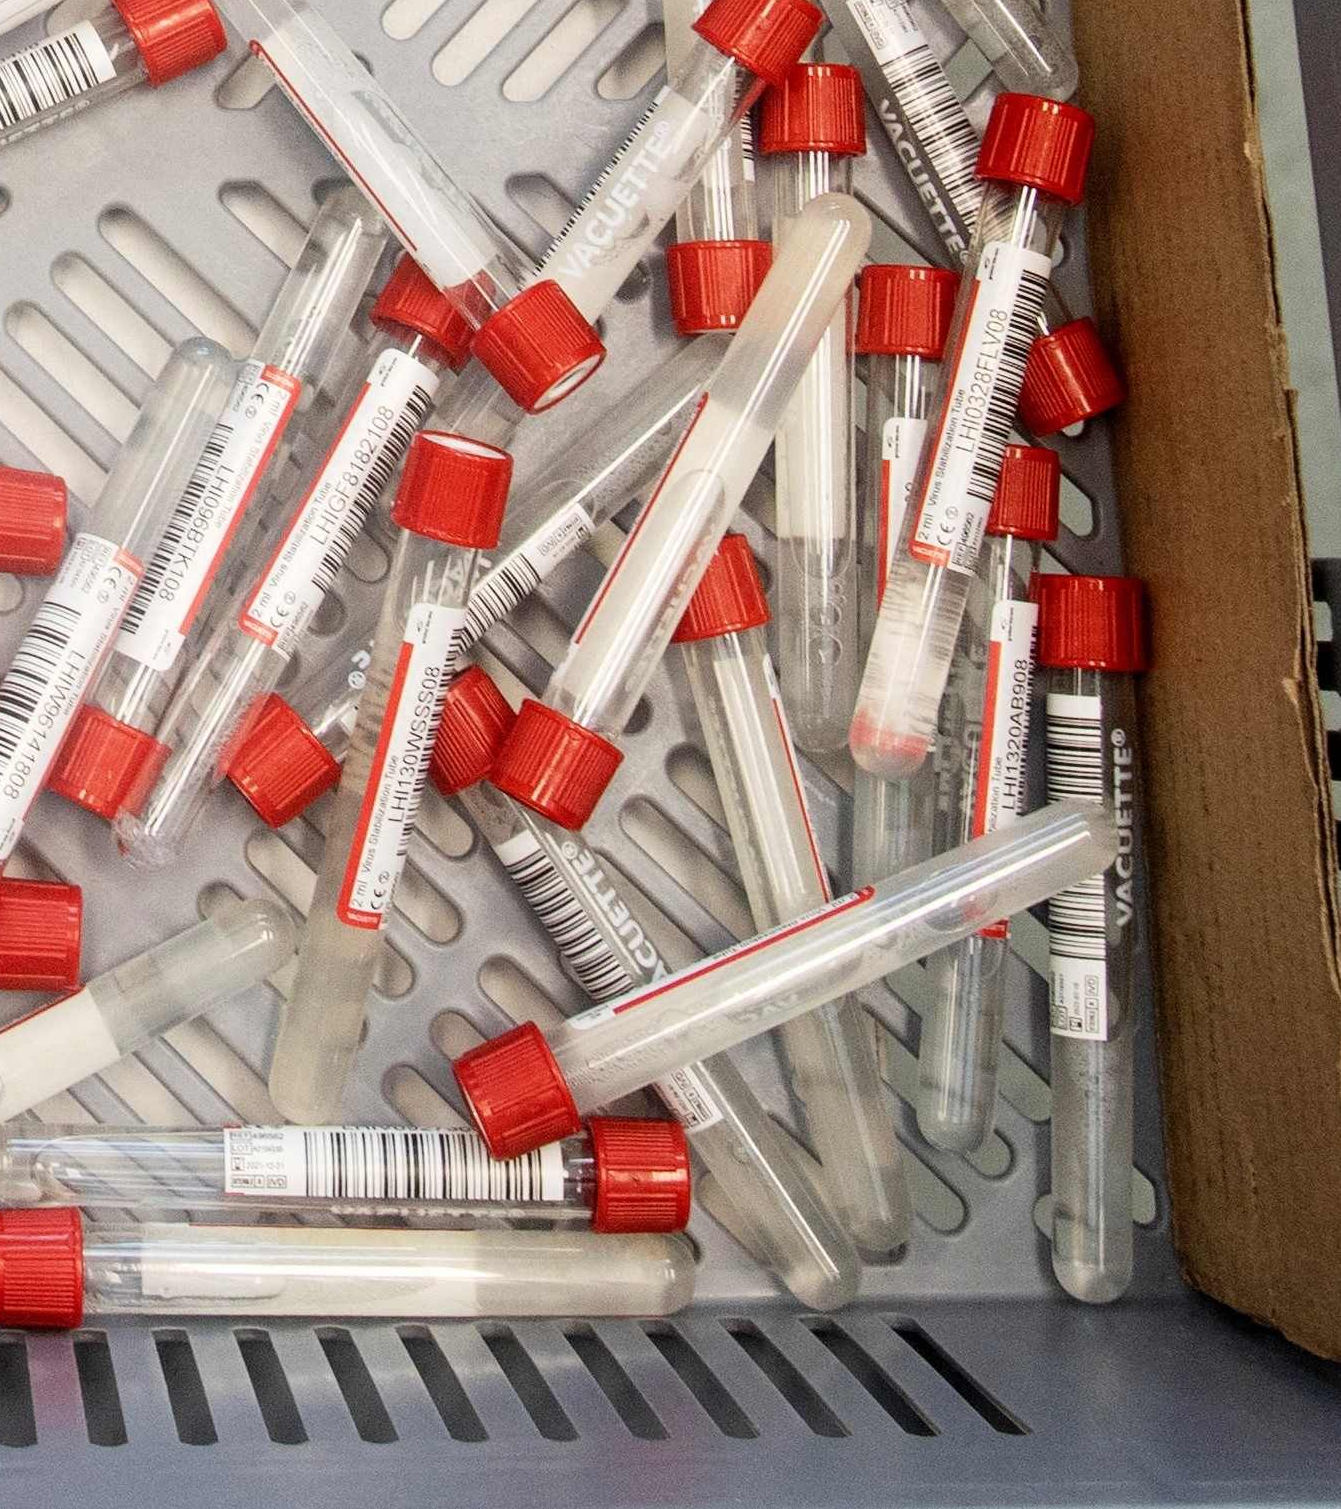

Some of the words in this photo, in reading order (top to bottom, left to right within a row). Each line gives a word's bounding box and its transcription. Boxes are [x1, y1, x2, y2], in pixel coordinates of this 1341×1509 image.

[958, 306, 1006, 453] LHI0328FLV08
[309, 403, 395, 546] LHIGF8182108
[921, 513, 933, 529] ml
[927, 479, 942, 507] Virus
[952, 388, 965, 414] Tube
[157, 464, 234, 602] LHI096BTK108
[267, 560, 288, 588] Virus
[313, 480, 332, 506] Tube
[2, 650, 85, 801] LHIW96141808
[387, 663, 440, 823] LHI130WSSS08
[992, 756, 1003, 781] Tube
[1000, 658, 1027, 809] LHI1320AB908
[360, 845, 375, 873] Virus
[385, 754, 399, 779] Tube
